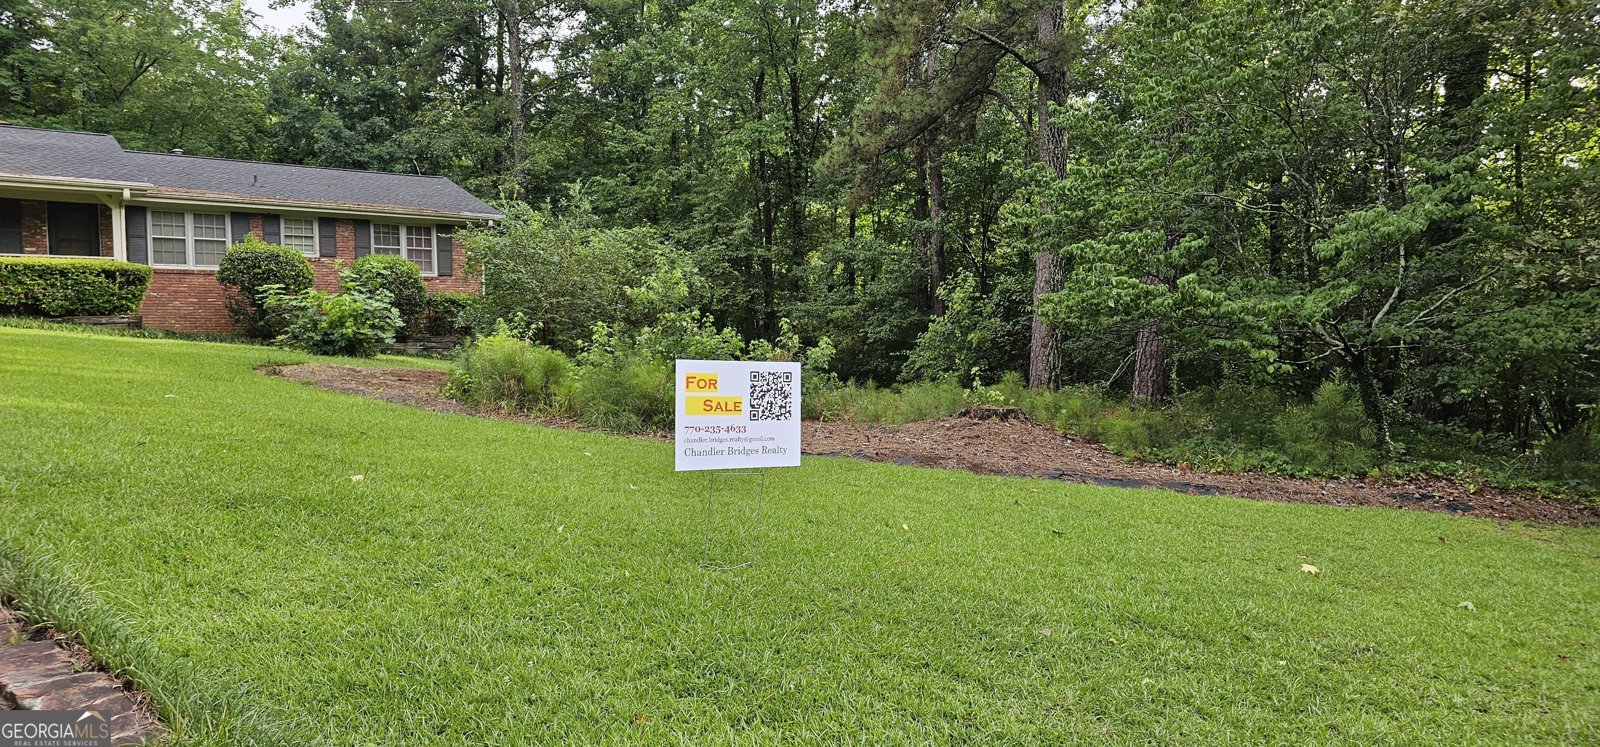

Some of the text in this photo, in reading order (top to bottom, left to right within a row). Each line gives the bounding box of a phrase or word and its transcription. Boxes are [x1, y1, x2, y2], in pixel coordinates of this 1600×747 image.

[685, 424, 747, 434] 770-235-4633
[684, 436, 775, 444] chandler.bridges.realty@gmail.com
[684, 445, 788, 457] Chandler Bridges Realty
